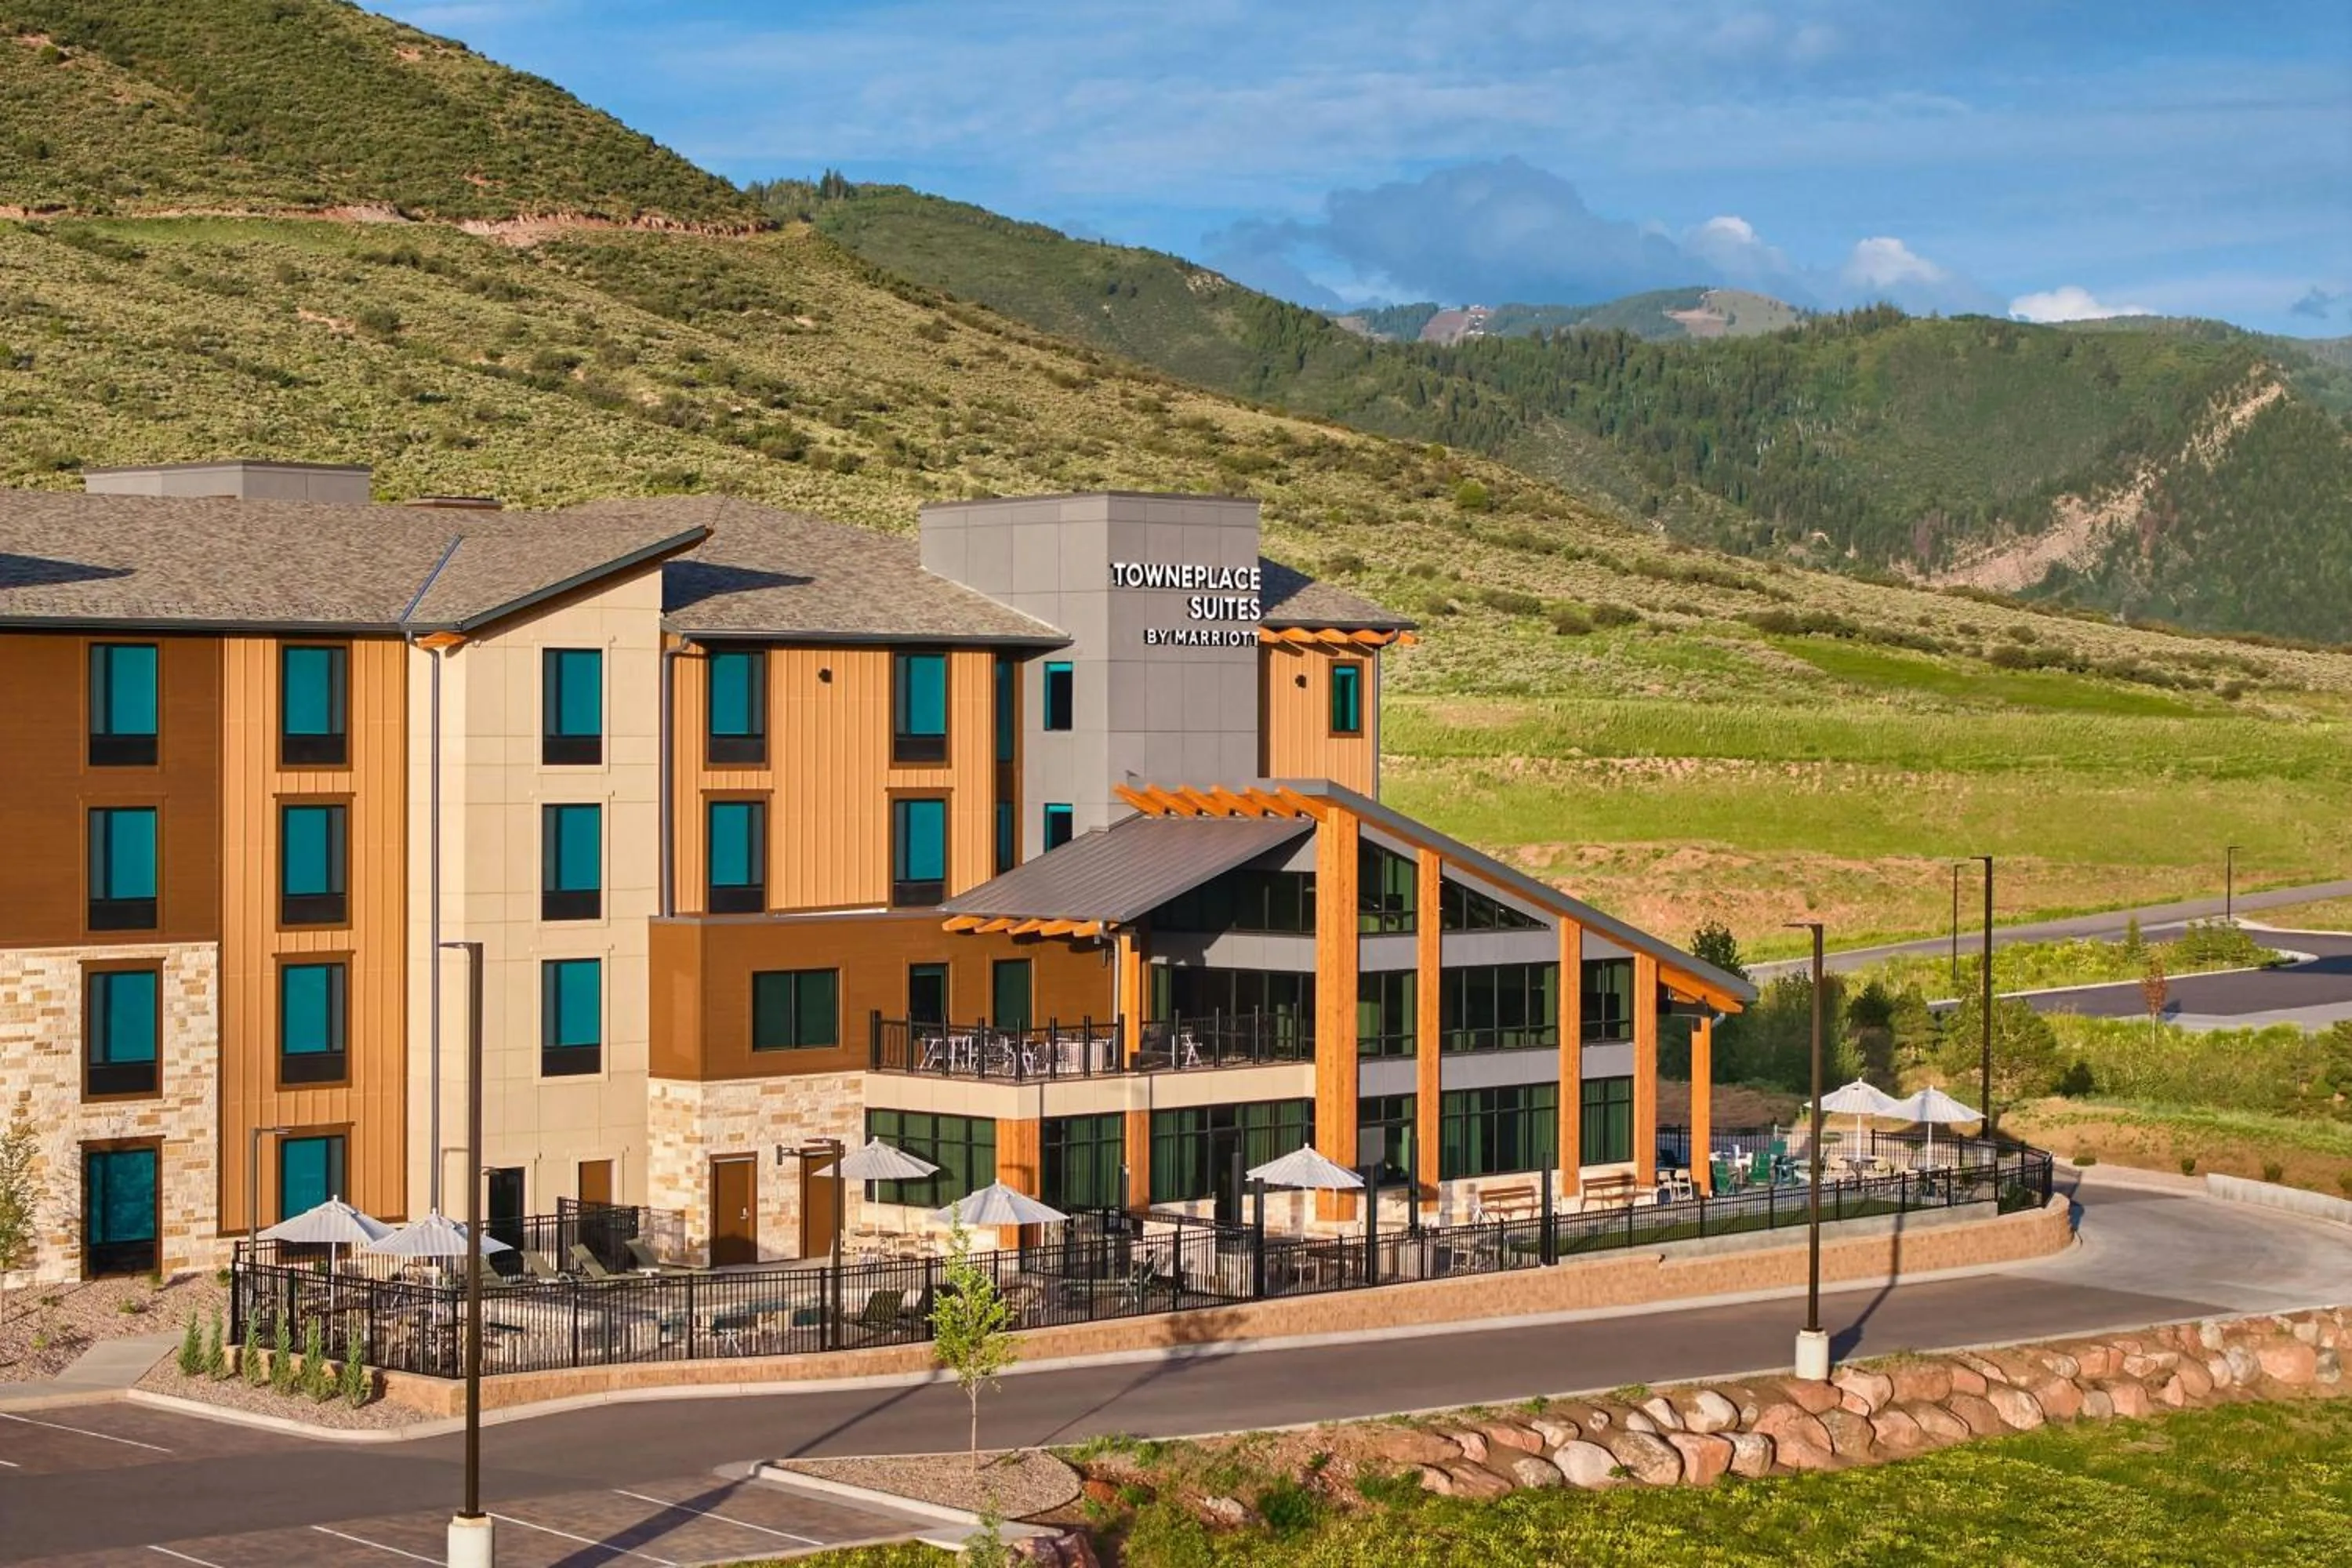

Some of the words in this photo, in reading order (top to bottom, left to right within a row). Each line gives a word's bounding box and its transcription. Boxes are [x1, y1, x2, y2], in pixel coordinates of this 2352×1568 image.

[1113, 562, 1261, 590] TOWNEPLACE
[1190, 596, 1261, 620] SUITES
[1147, 628, 1167, 644] BY
[1175, 629, 1261, 646] MARRIOTT
